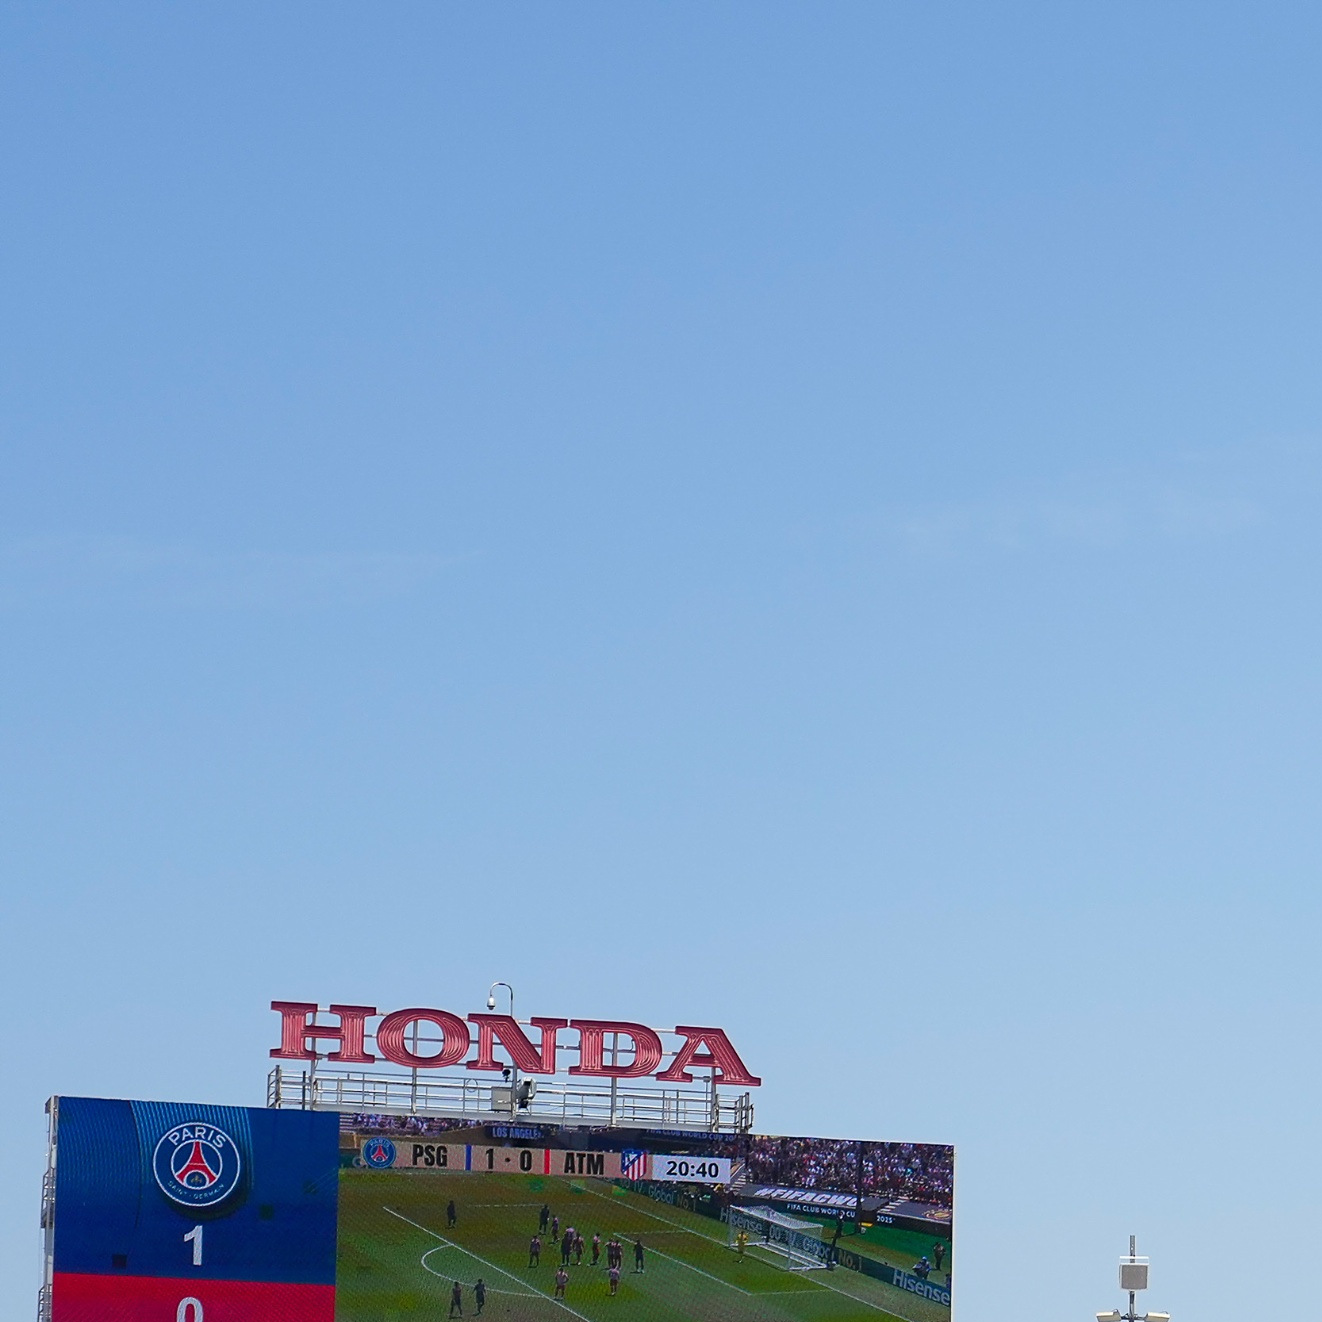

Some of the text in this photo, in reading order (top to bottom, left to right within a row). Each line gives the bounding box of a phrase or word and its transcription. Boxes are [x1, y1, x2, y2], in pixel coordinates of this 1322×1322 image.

[269, 1000, 762, 1086] HONDA
[167, 1126, 227, 1149] PARIS
[492, 1128, 508, 1139] LOS
[411, 1144, 720, 1179] PSG 1 0 ATM 20:40
[786, 1203, 801, 1211] FIFA
[802, 1205, 820, 1214] CLUB
[183, 1225, 203, 1266] 1
[892, 1269, 950, 1306] Hisense
